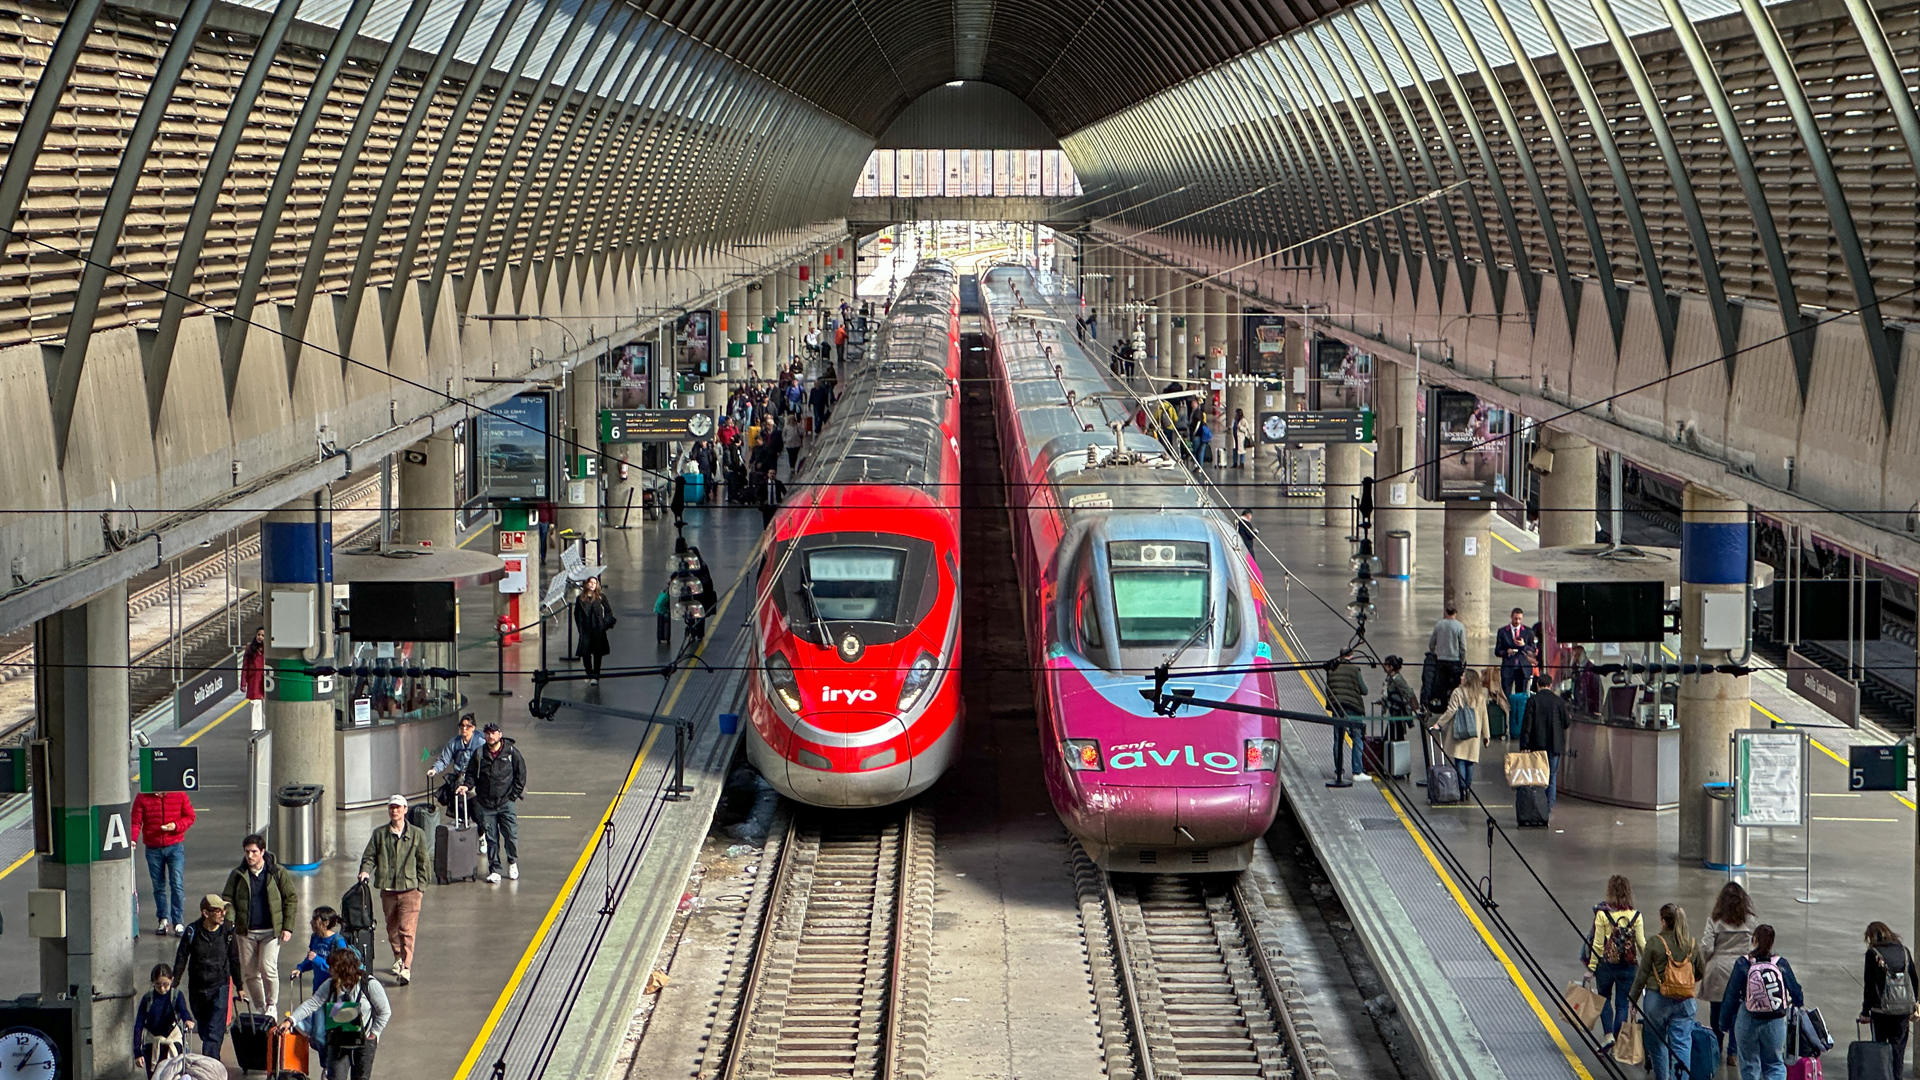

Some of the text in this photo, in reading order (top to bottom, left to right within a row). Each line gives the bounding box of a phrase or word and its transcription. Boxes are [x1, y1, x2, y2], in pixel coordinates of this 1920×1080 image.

[611, 426, 620, 439] 6
[1354, 427, 1364, 440] 5
[586, 458, 596, 475] E
[528, 507, 540, 526] D
[822, 685, 878, 705] iryo
[1110, 740, 1156, 752] renfe
[1110, 745, 1238, 769] avlo
[182, 768, 196, 789] 6
[1852, 768, 1865, 789] 5
[103, 813, 129, 851] A
[1762, 970, 1783, 1011] FILA
[16, 1036, 30, 1046] 12
[43, 1060, 52, 1070] 3
